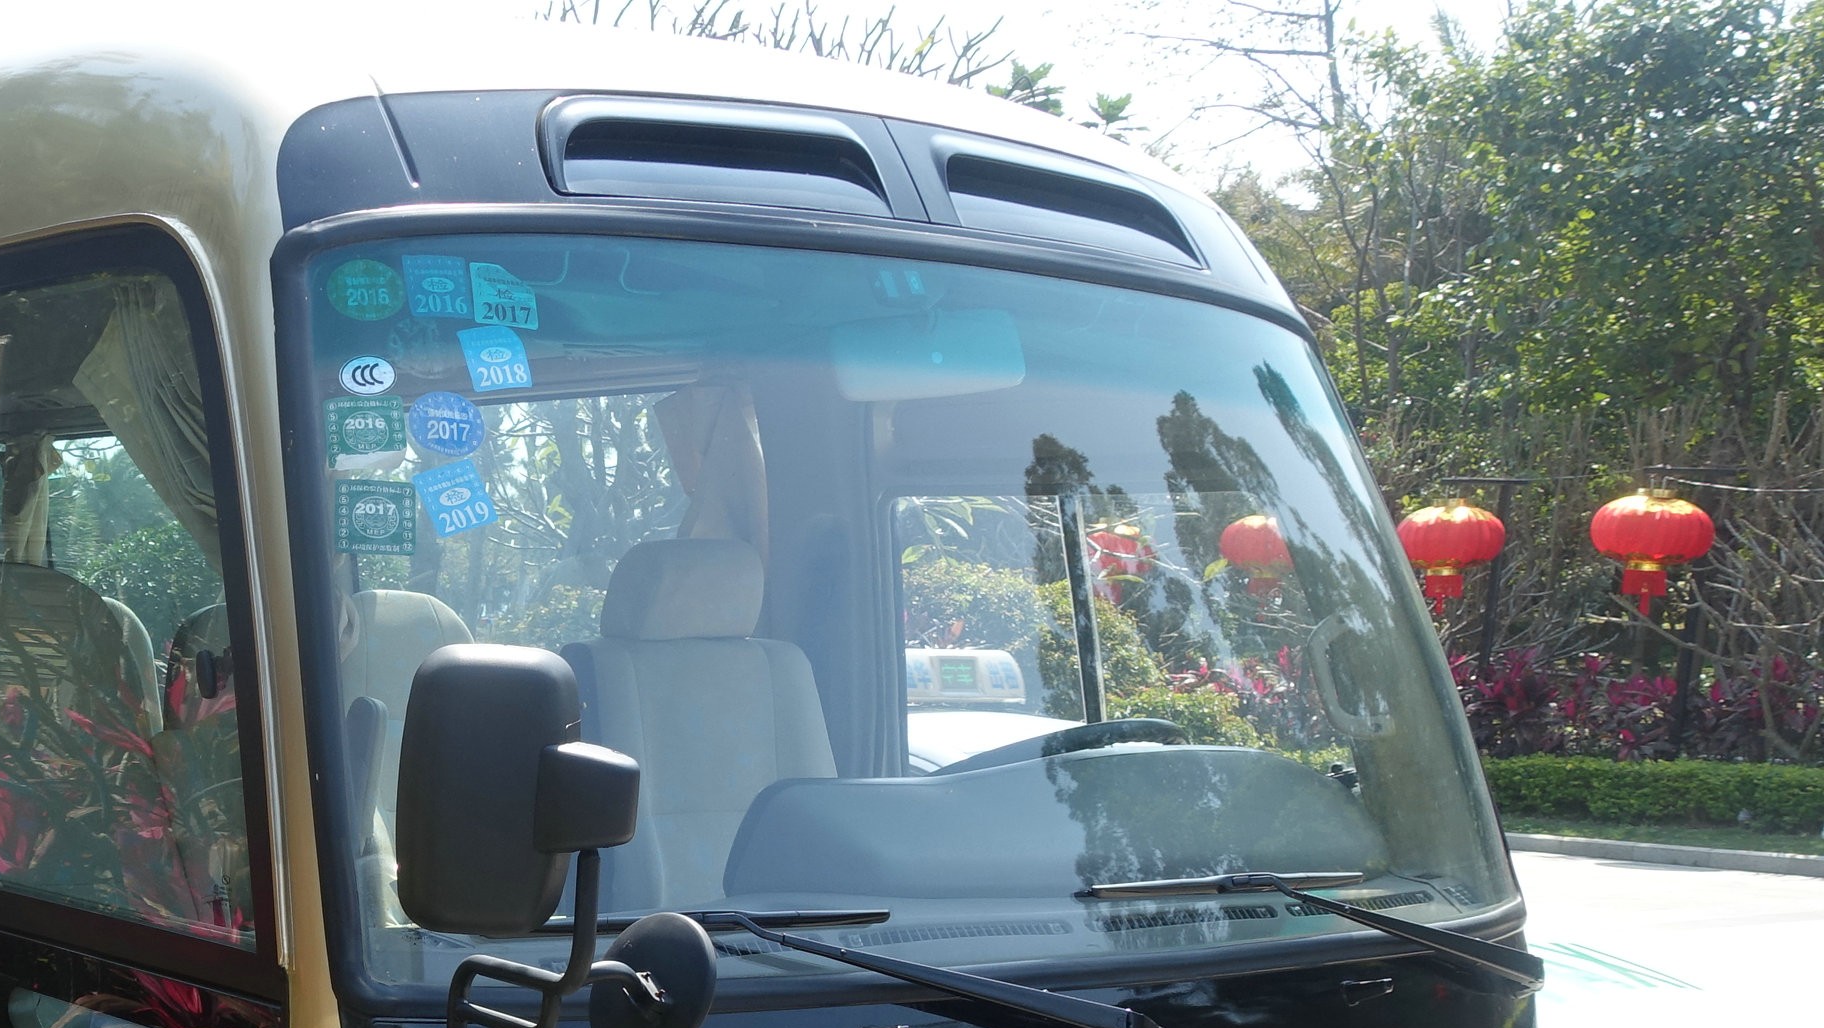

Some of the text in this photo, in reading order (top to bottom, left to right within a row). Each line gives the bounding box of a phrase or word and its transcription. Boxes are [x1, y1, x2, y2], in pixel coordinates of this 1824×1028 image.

[346, 287, 389, 306] 2016
[415, 294, 467, 314] 2016
[482, 301, 531, 324] 2017
[477, 363, 528, 387] 2018
[345, 418, 385, 429] 2016
[427, 420, 470, 441] 2017
[355, 503, 396, 515] 2017
[439, 501, 489, 533] 2019
